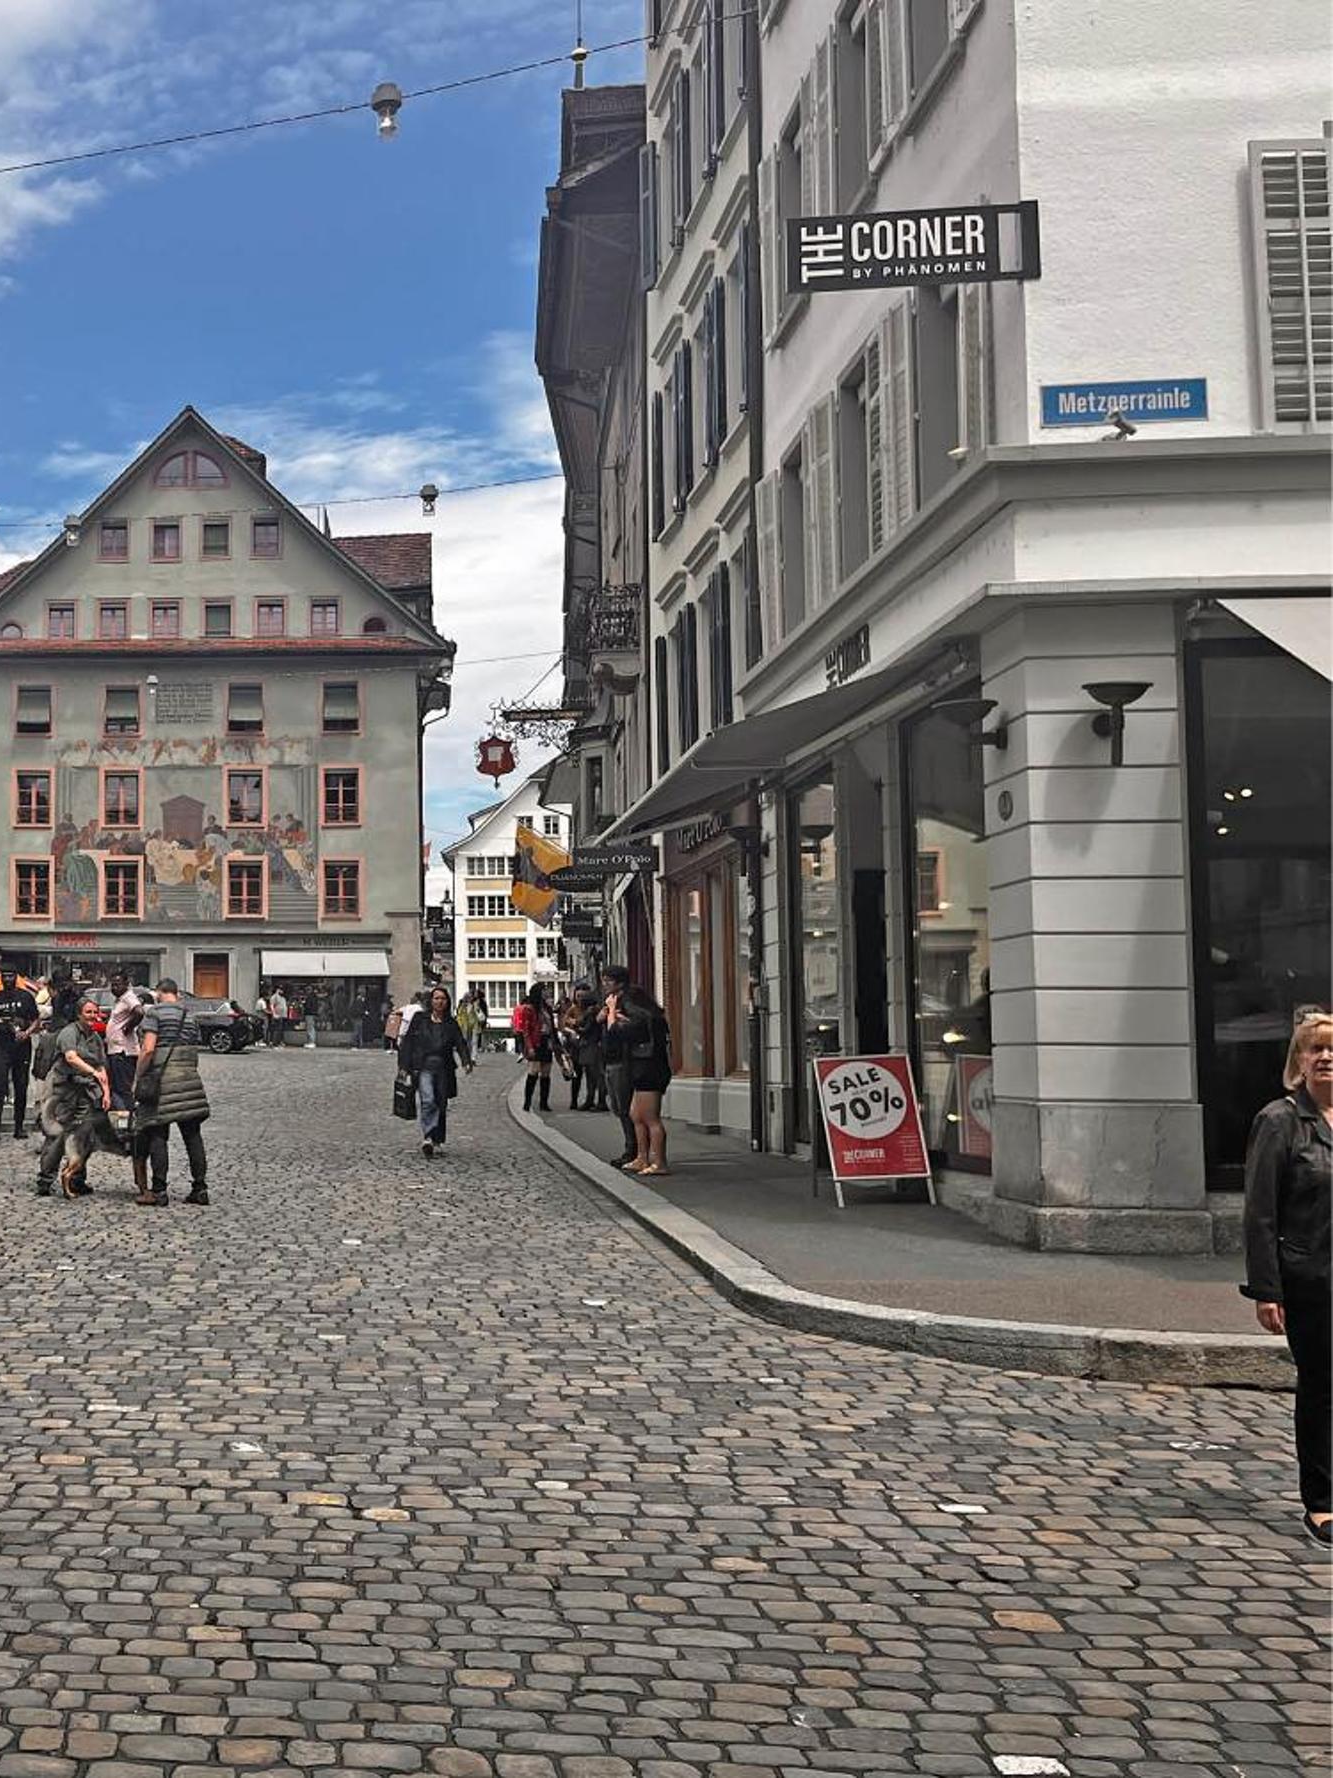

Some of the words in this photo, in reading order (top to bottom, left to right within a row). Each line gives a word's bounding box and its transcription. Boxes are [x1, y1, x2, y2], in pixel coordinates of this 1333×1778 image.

[801, 223, 844, 284] THE
[850, 214, 986, 262] CORNER
[852, 268, 872, 279] BY
[1058, 387, 1191, 415] Metzgerrainle
[577, 856, 609, 866] Marc
[611, 854, 652, 865] O'Polo
[827, 1067, 882, 1095] SALE
[829, 1086, 904, 1127] 70%
